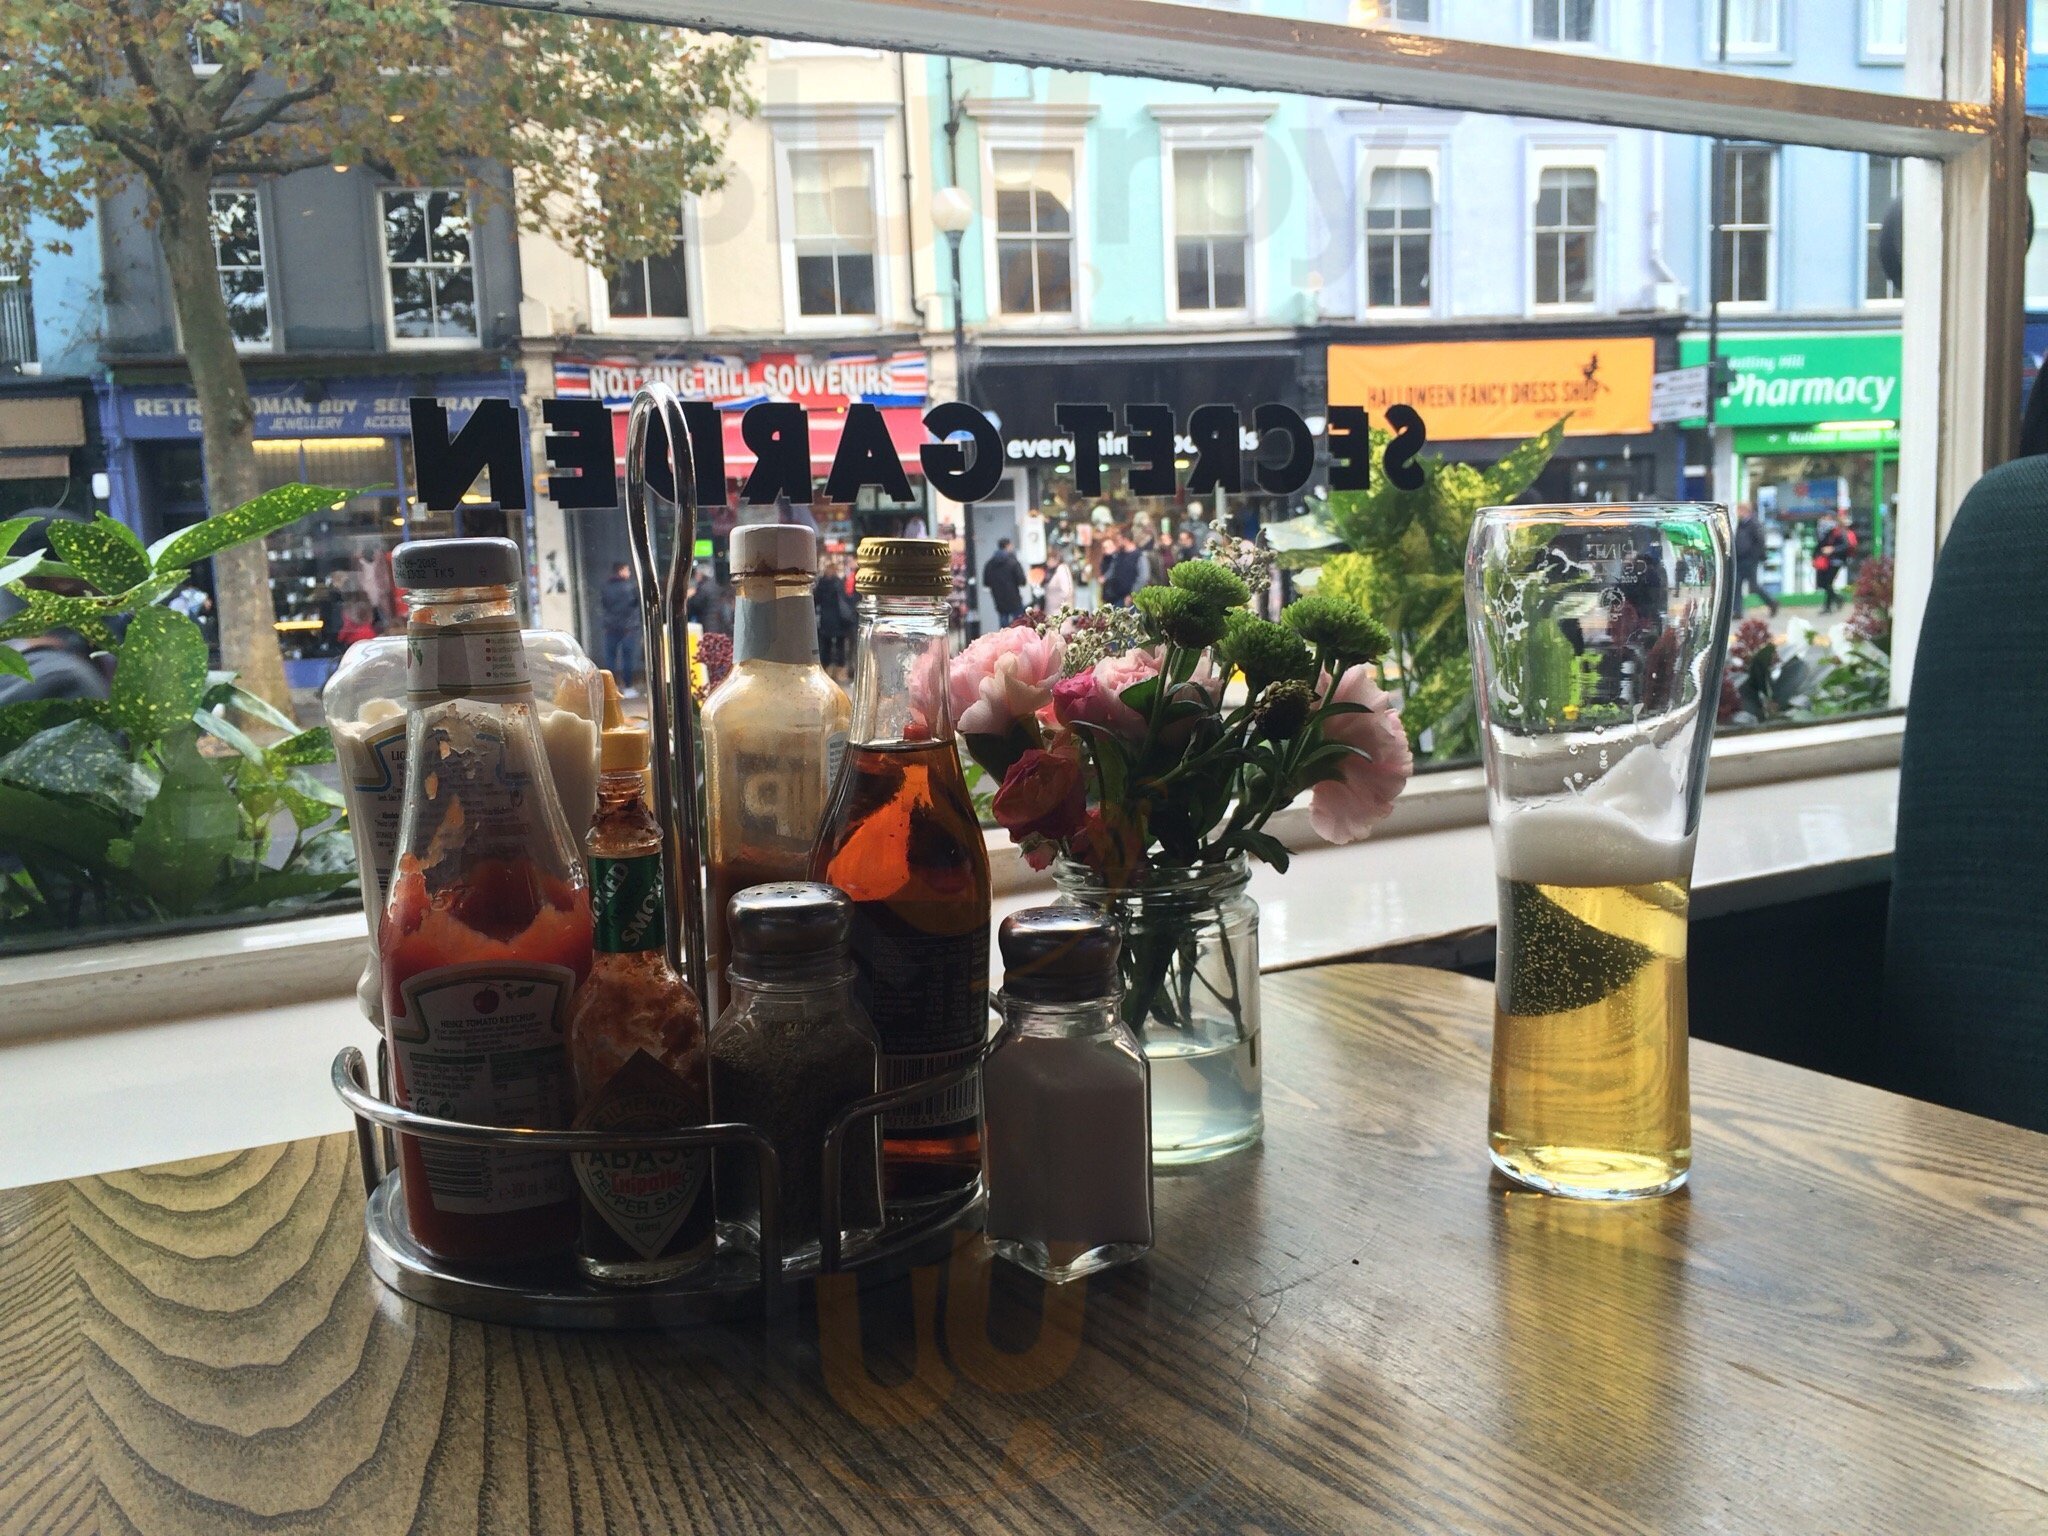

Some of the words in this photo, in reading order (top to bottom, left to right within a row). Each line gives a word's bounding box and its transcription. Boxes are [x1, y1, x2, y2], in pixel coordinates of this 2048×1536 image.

[704, 365, 755, 396] HILL
[762, 363, 895, 396] SOUVENIRS
[1368, 384, 1456, 408] HALLOWEEN
[1461, 383, 1507, 405] FANCY
[1511, 381, 1557, 404] DRESS
[1562, 379, 1599, 402] SHOP
[1721, 373, 1896, 413] Pharmacy
[134, 397, 203, 416] RETR
[269, 417, 344, 431] JEWELLERY
[466, 1017, 498, 1027] TOMATO
[500, 1013, 537, 1025] KETCHUP
[592, 1169, 650, 1214] PEPPER
